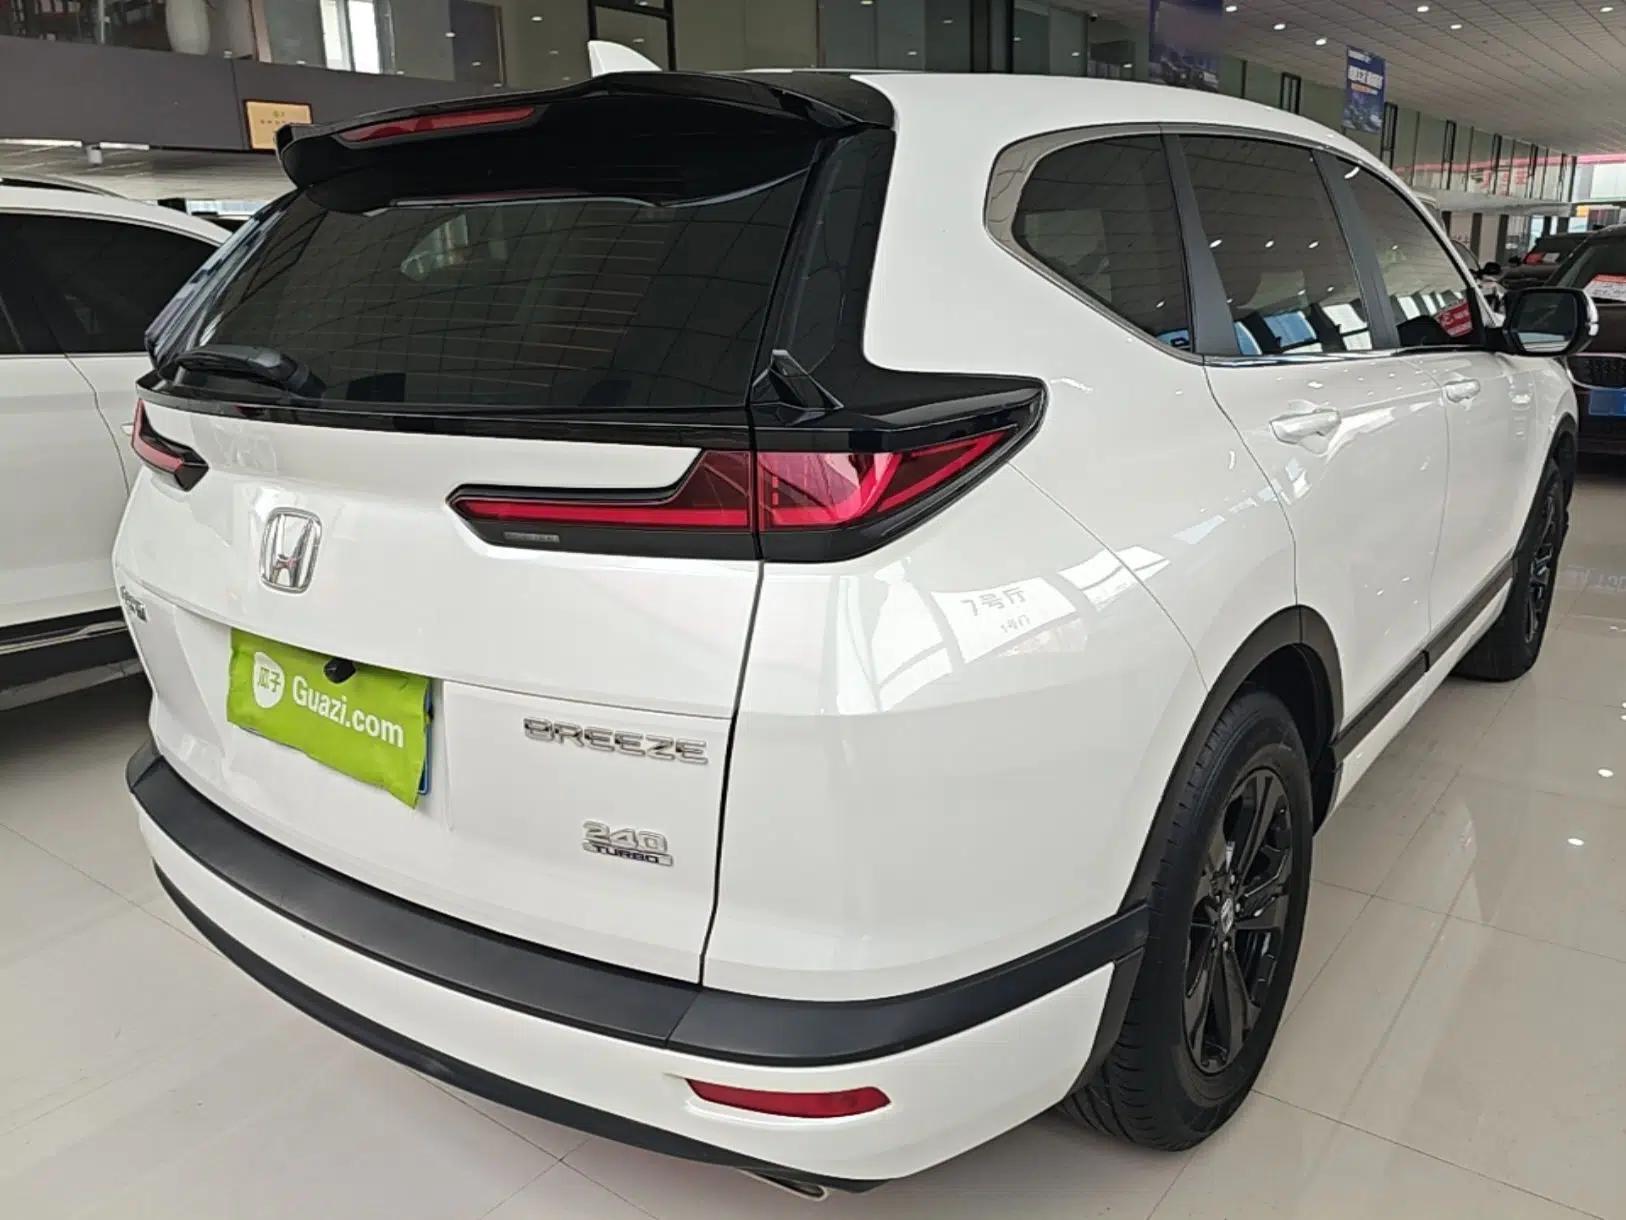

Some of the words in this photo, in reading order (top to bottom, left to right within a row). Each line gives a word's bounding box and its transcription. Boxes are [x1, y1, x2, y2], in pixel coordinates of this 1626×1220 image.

[961, 587, 1026, 616] 7号厅
[292, 675, 404, 748] Guazi.com
[523, 718, 709, 765] BREEZE
[582, 820, 669, 852] 240
[593, 845, 661, 865] TURBO
